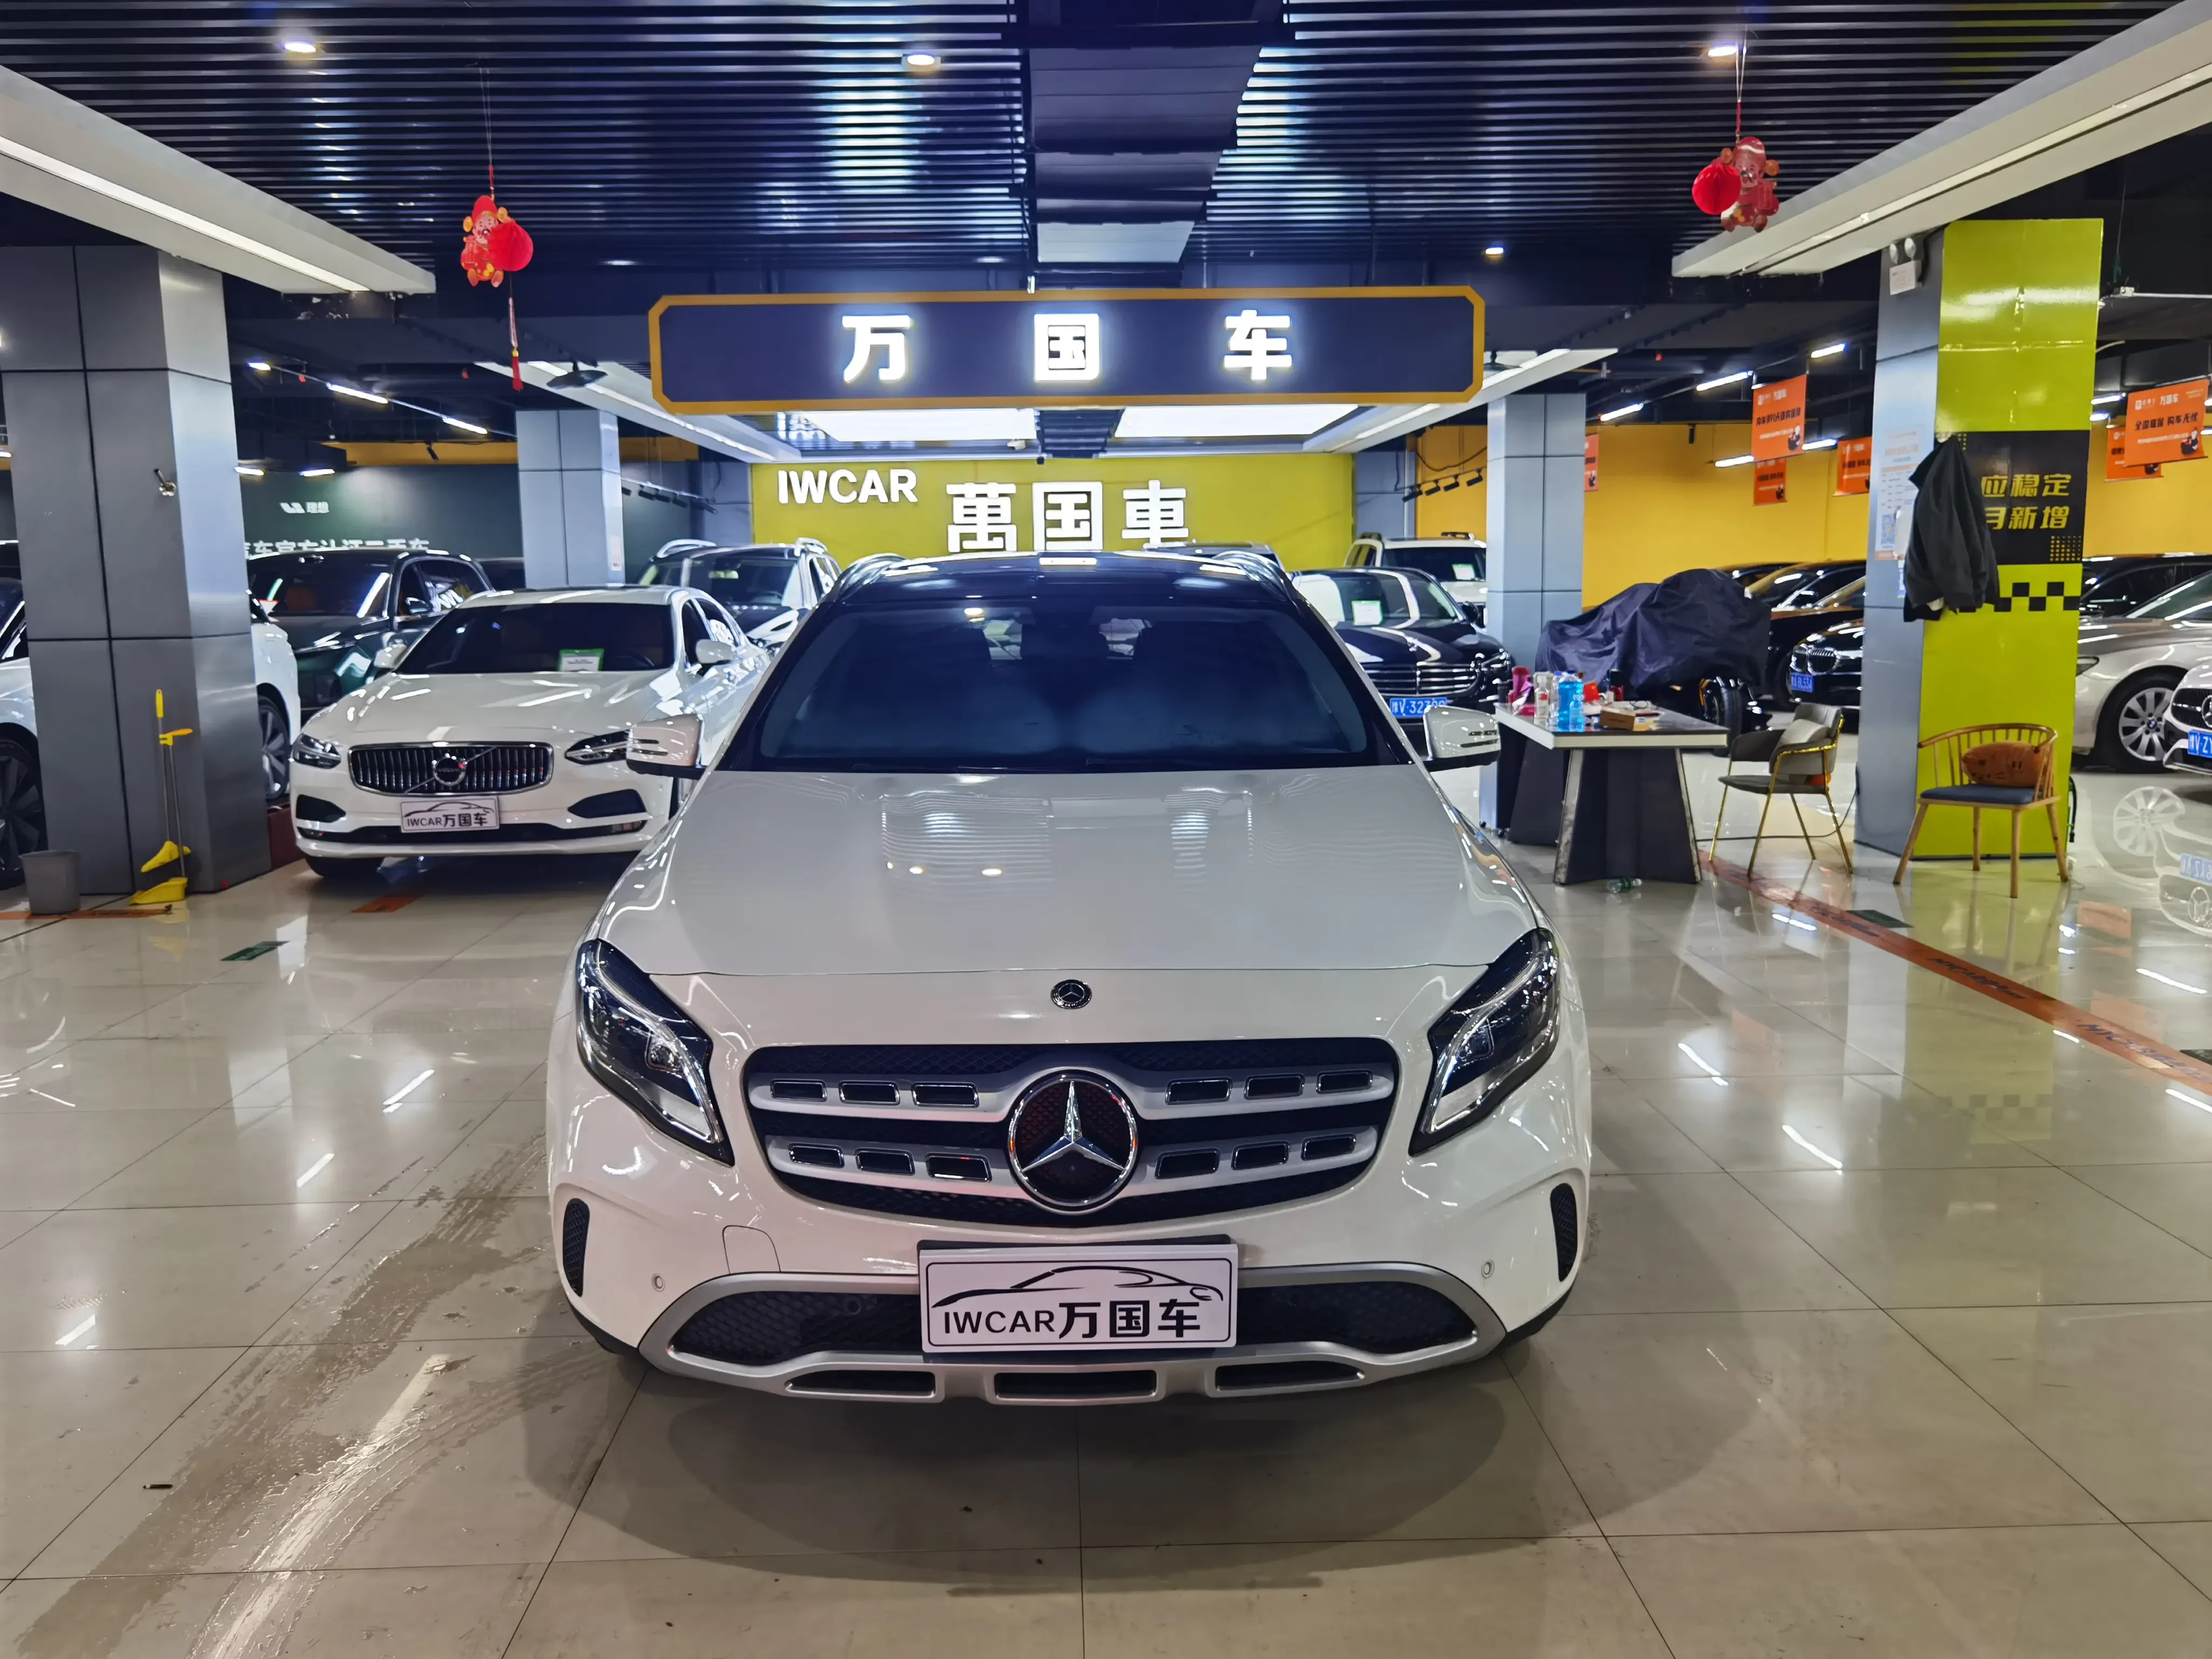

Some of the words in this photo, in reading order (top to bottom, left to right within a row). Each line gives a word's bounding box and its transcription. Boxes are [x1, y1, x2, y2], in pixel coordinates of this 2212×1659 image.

[842, 309, 1292, 382] 万国车
[778, 469, 918, 504] IWCAR
[407, 813, 488, 828] IWCAR万国车
[944, 1299, 1201, 1339] IWCAR万国车
